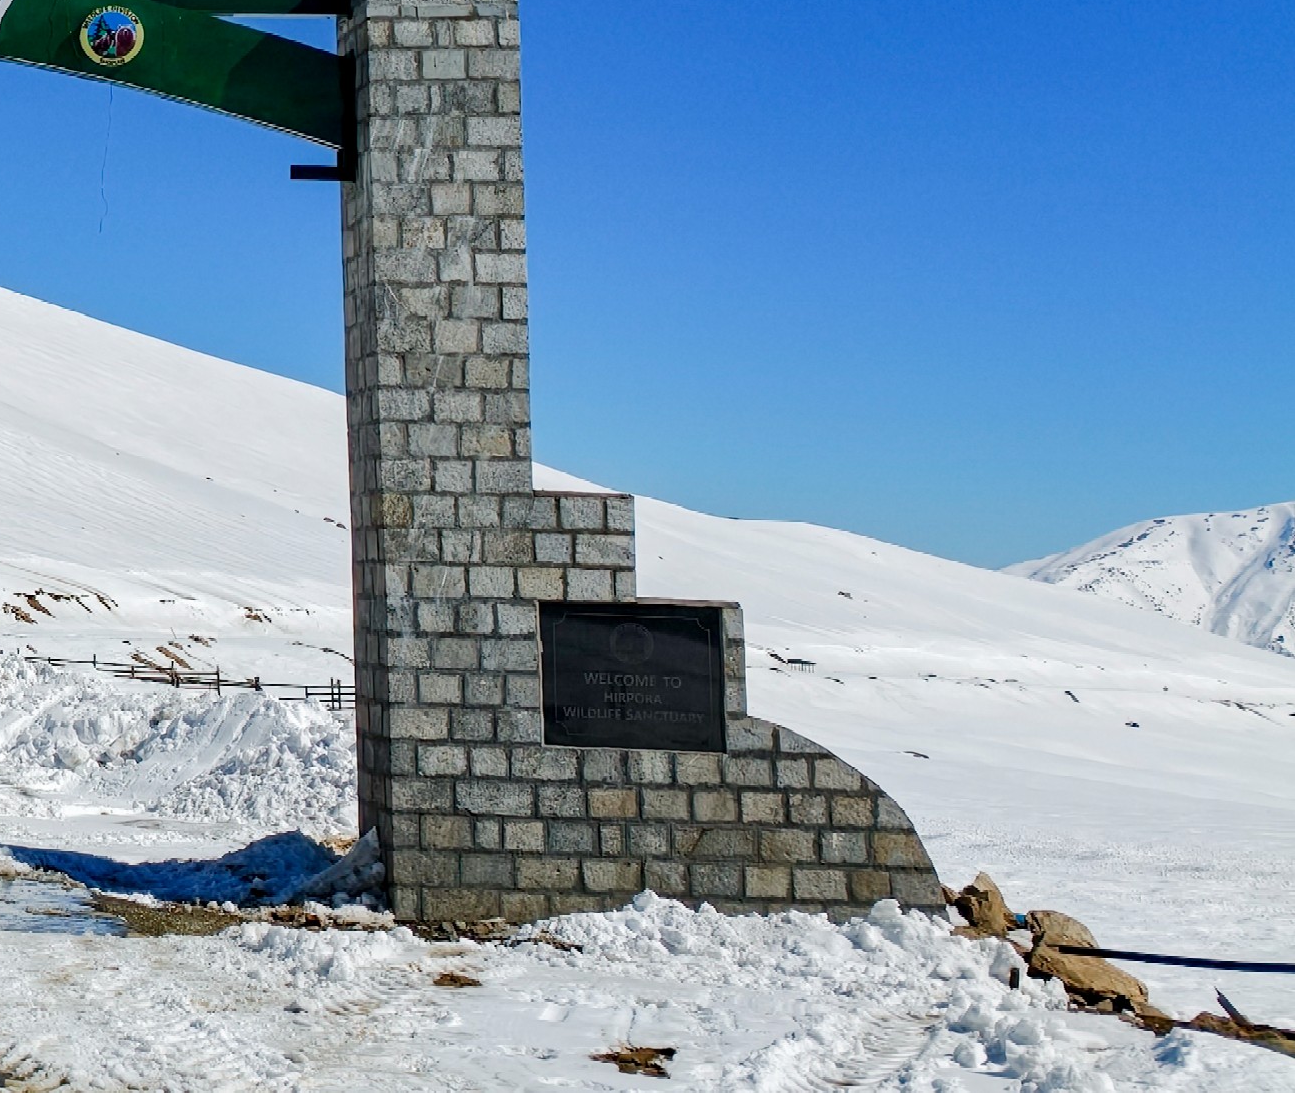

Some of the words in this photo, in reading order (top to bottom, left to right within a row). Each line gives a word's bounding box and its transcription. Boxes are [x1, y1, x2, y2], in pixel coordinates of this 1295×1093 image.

[583, 672, 656, 688] WELCOME
[662, 676, 682, 689] TO
[603, 692, 663, 705] HIRPORA
[563, 706, 621, 720] WILDLIFE
[625, 708, 705, 724] SANCTUARY
